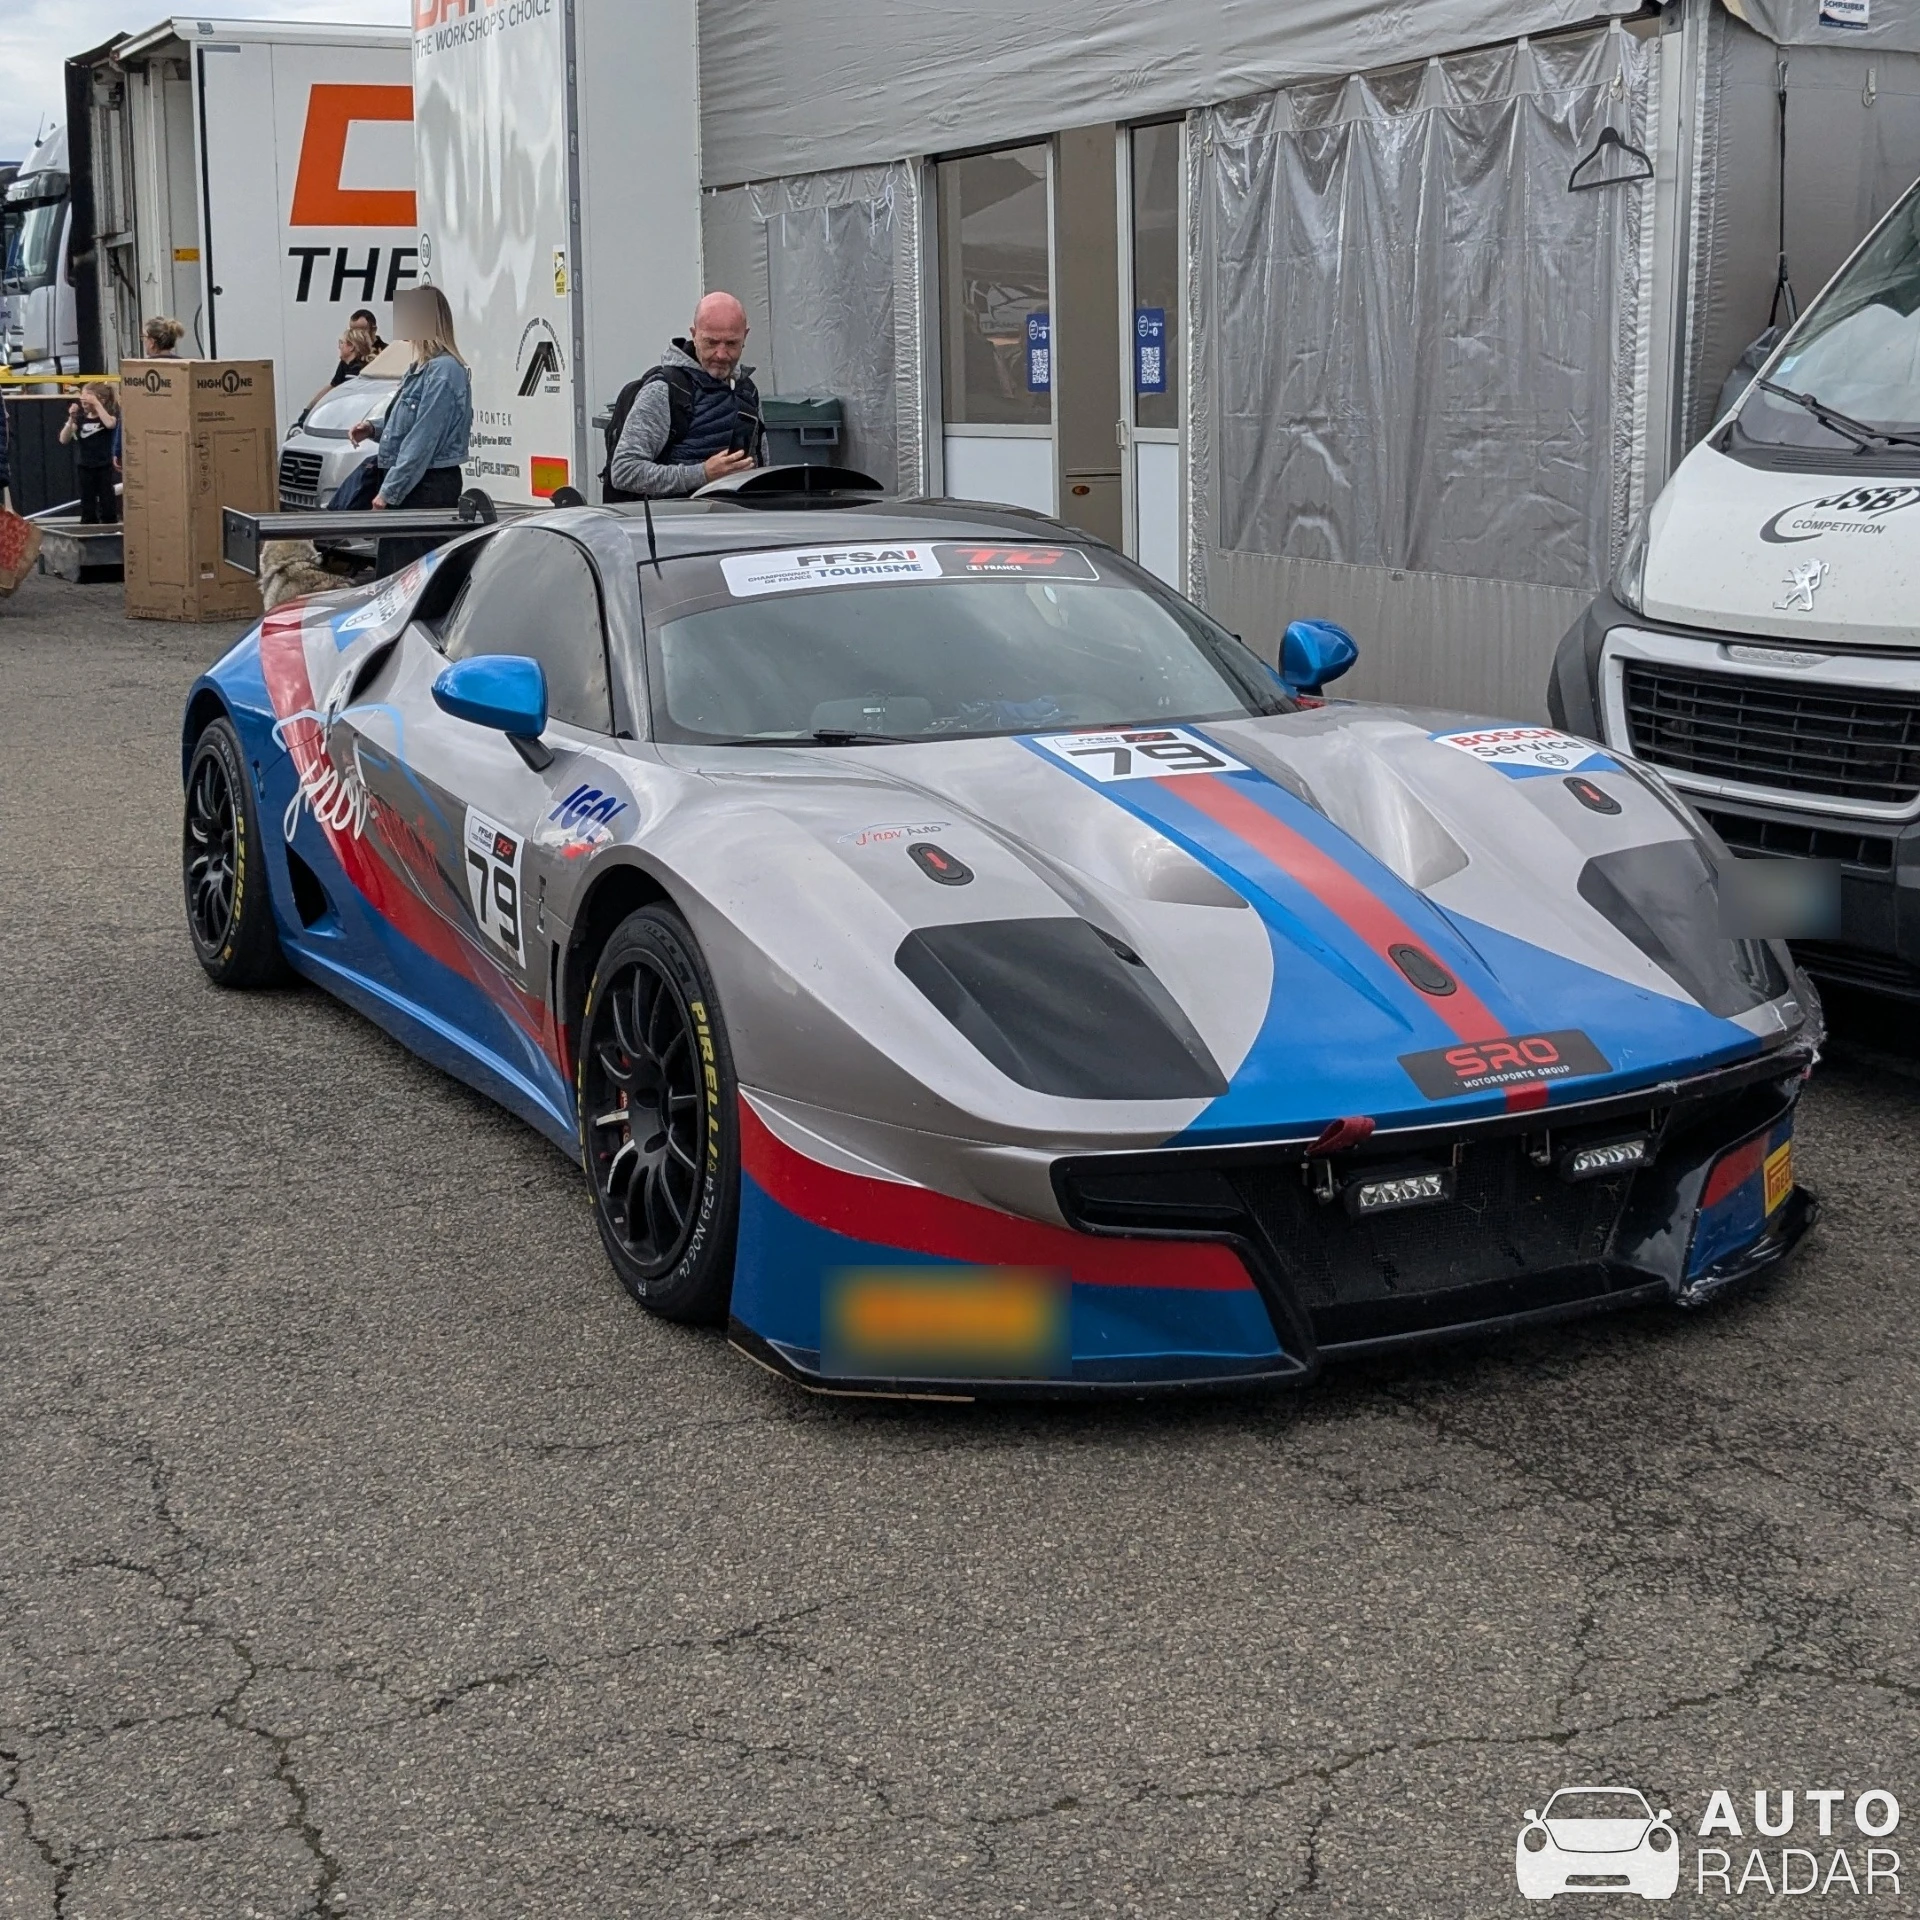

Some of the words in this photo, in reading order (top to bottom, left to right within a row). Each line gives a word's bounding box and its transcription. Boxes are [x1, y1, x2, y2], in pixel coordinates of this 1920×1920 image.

[415, 35, 432, 59] THE
[436, 9, 505, 51] WORKSHOP'S
[509, 0, 551, 26] CHOICE
[1792, 519, 1886, 534] COMPETITION
[748, 570, 811, 583] CHAMPIONNAT
[778, 575, 812, 583] FRANCE
[815, 564, 923, 578] TOURISME
[1448, 729, 1562, 747] BOSCH
[1472, 739, 1585, 757] Service
[1066, 742, 1227, 776] 79
[907, 826, 941, 836] Auto
[467, 848, 520, 951] 79
[1445, 1038, 1559, 1076] SRO
[690, 1002, 718, 1161] PIRELLI
[1463, 1069, 1535, 1088] MOTORSPORTS
[1537, 1065, 1570, 1077] GROUP
